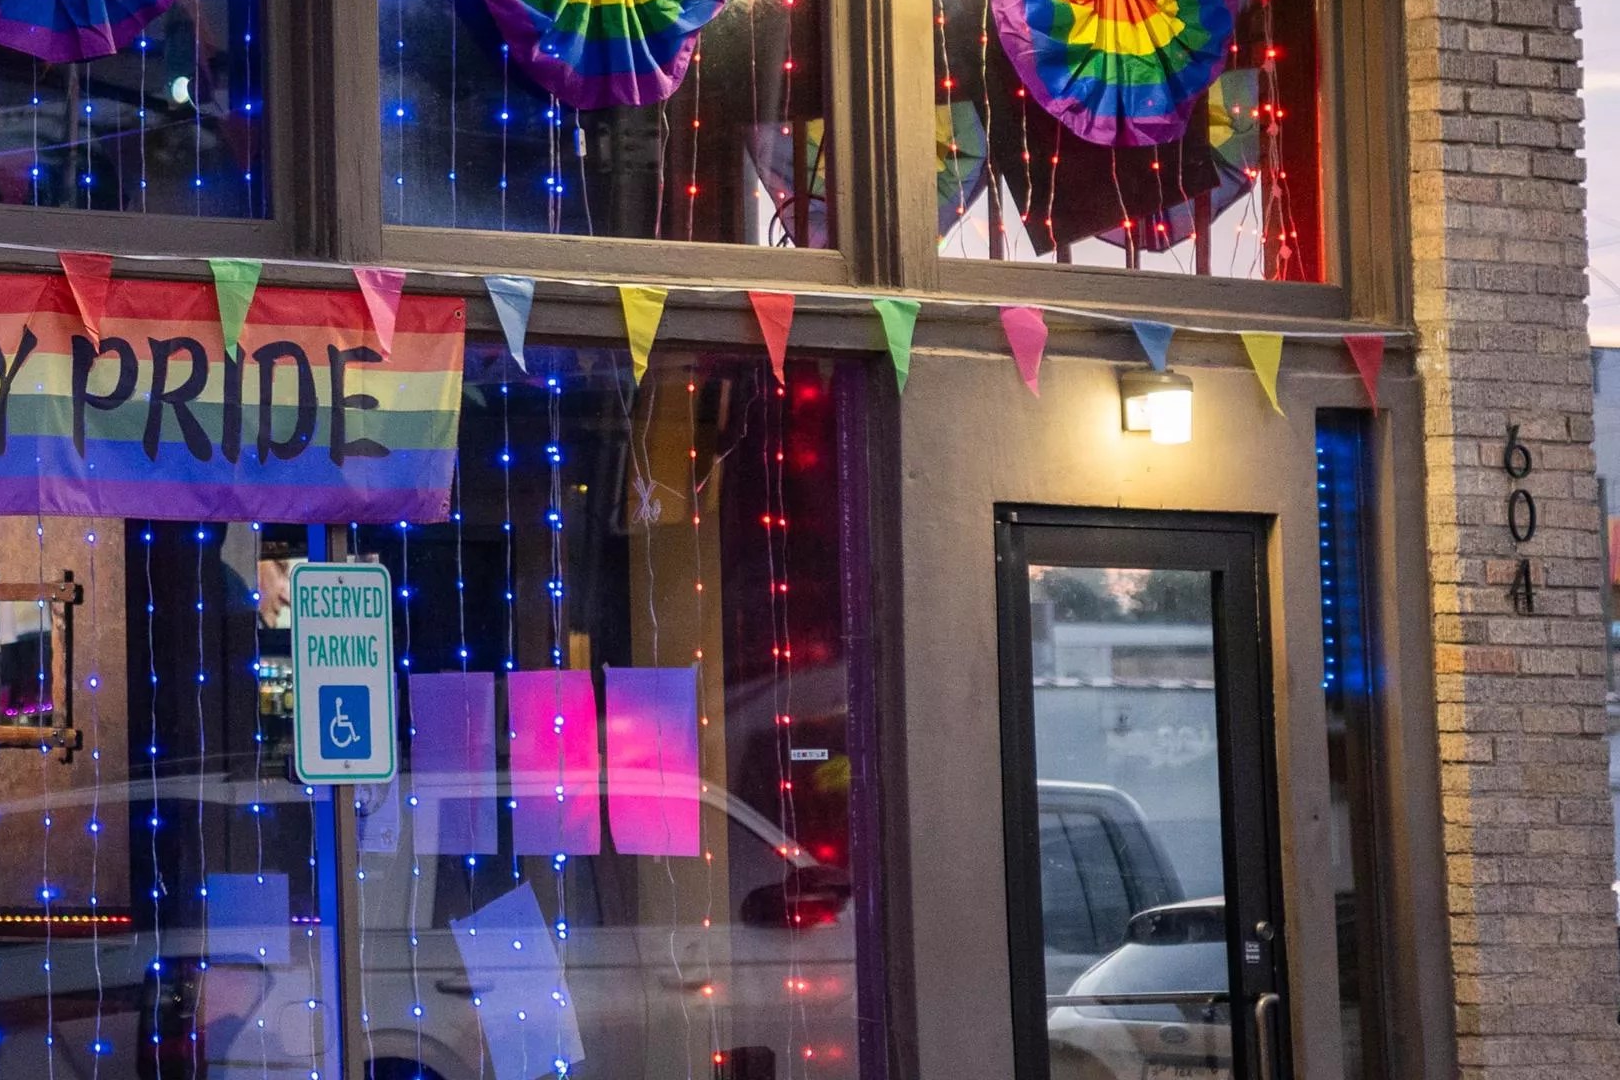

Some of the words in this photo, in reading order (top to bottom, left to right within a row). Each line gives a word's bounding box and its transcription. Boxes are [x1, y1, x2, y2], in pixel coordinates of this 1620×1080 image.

[71, 335, 391, 468] PRIDE
[1504, 424, 1537, 612] 604
[300, 586, 383, 618] RESERVED
[307, 634, 378, 667] PARKING
